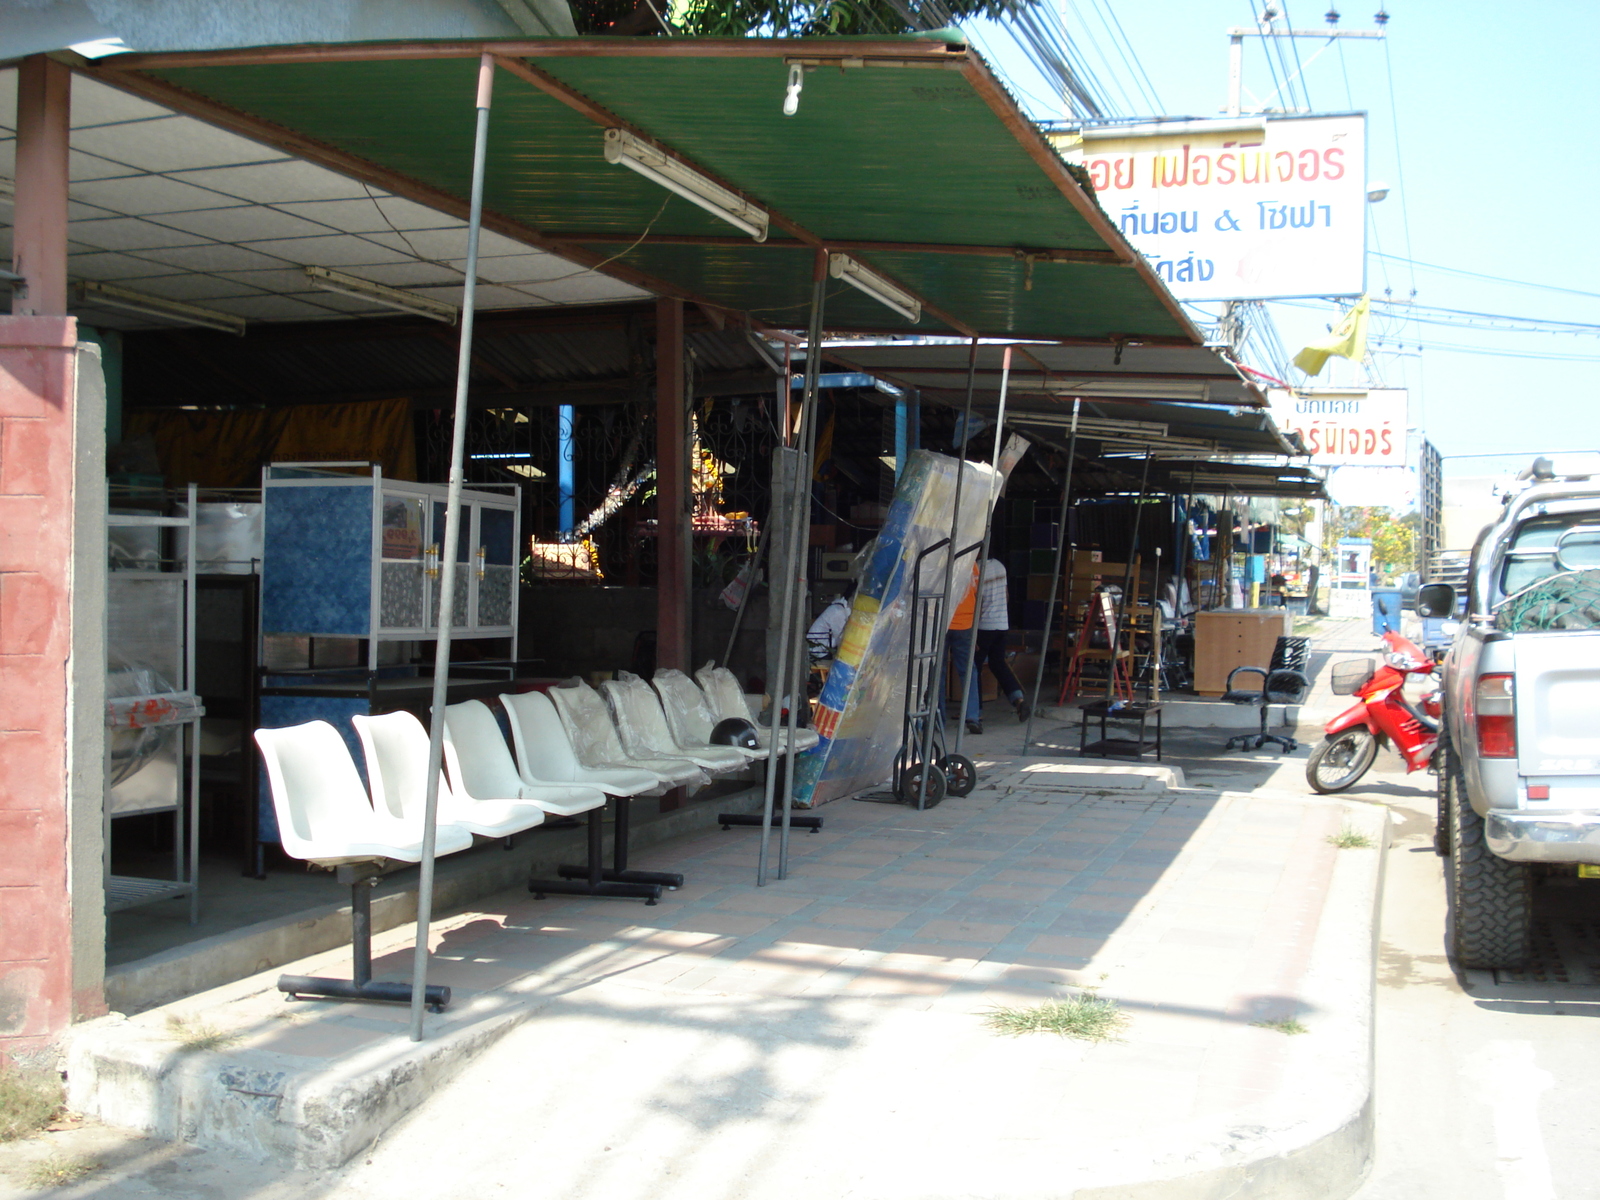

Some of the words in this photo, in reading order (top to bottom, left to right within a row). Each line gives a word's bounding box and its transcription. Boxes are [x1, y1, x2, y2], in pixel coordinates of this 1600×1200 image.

[1081, 157, 1135, 192] อย
[1151, 132, 1348, 189] เฟอร์นิเจอร์
[1121, 199, 1198, 236] ที่นอน
[1213, 209, 1243, 232] &
[1256, 199, 1332, 231] โซฟา
[1141, 250, 1215, 283] ัดส่ง
